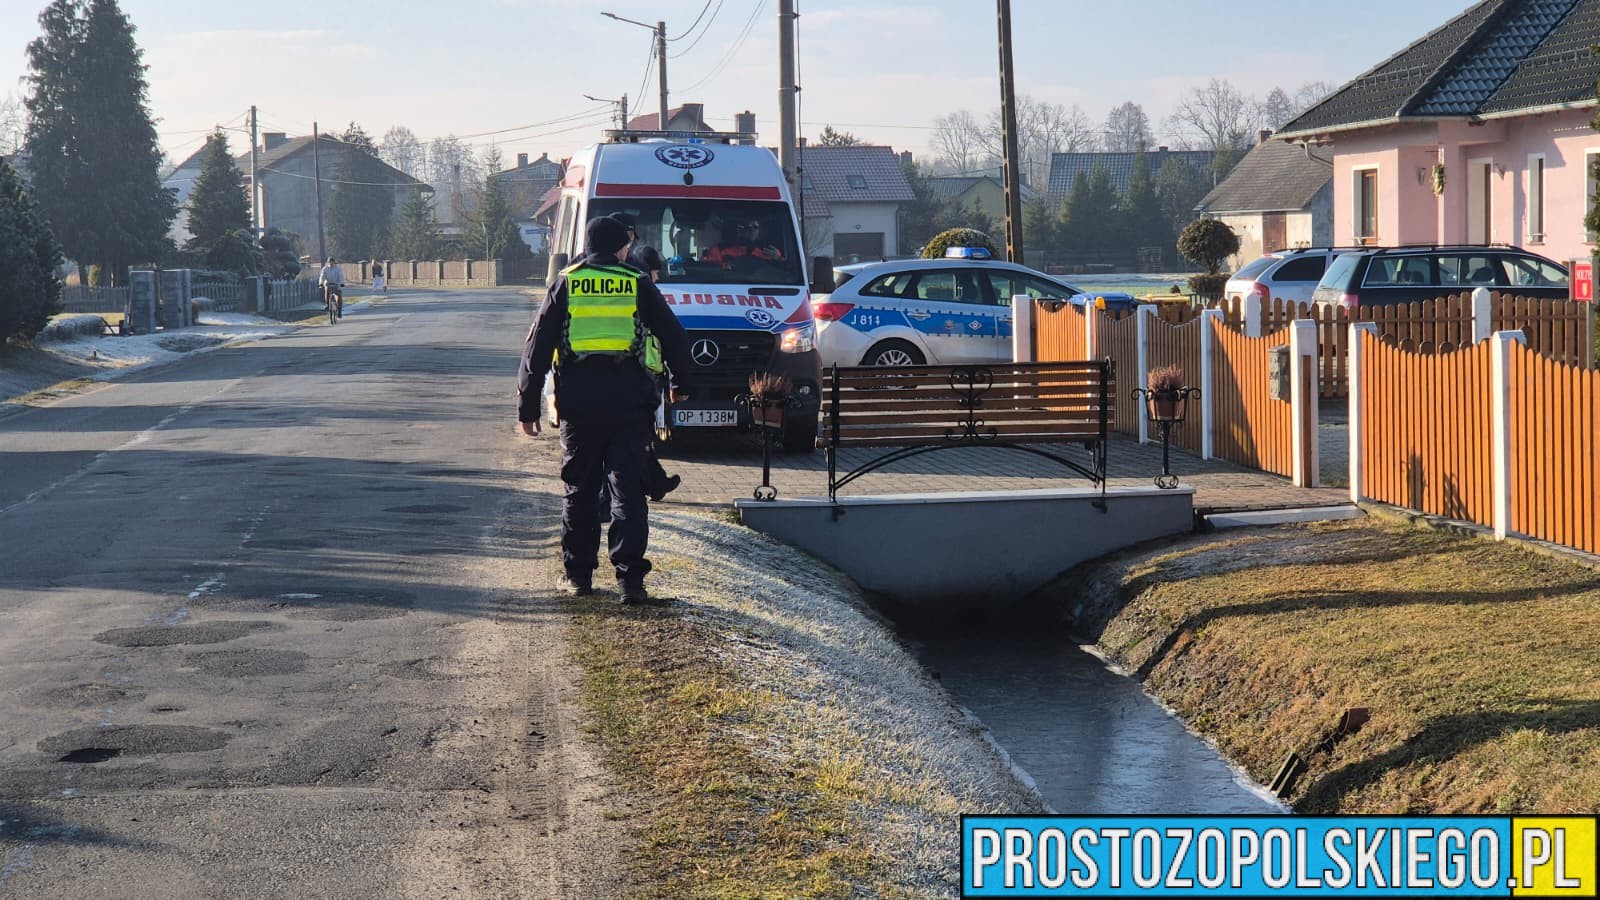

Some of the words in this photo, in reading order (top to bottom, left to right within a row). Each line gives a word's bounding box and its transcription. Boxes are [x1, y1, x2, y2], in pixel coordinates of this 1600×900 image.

[571, 279, 633, 294] POLICJA
[850, 314, 857, 325] J
[860, 314, 881, 326] 814
[678, 411, 694, 423] OP
[699, 411, 735, 423] 1338M
